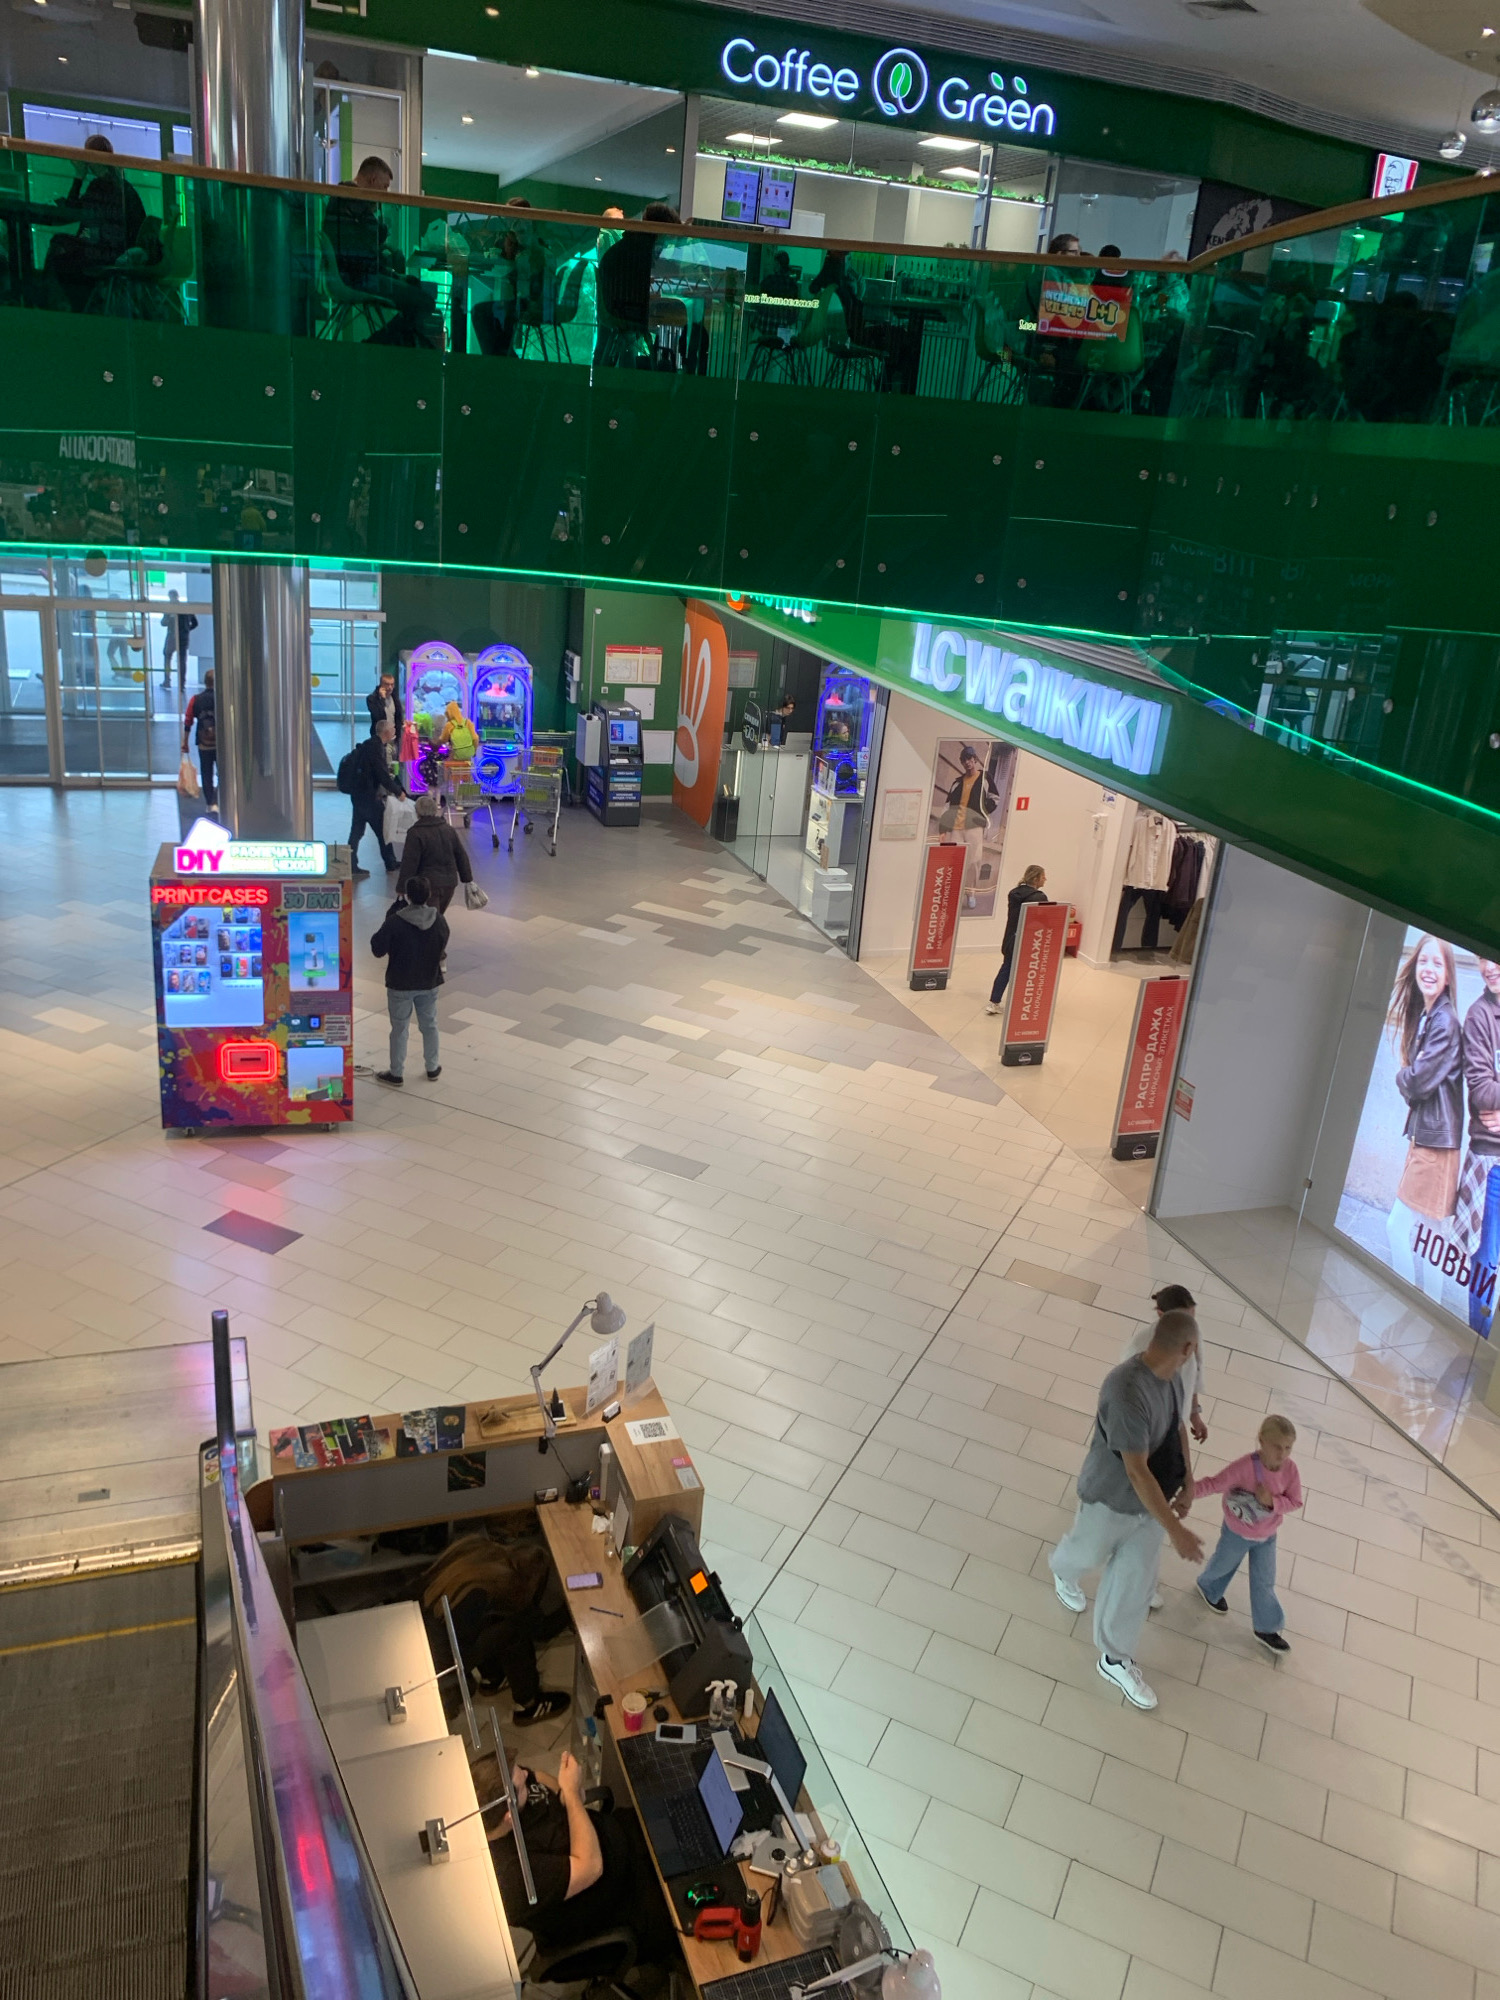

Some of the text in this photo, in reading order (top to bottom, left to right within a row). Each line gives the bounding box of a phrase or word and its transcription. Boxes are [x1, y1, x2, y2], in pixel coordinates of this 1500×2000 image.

[721, 38, 1056, 136] Coffee Green
[152, 887, 269, 904] PRINT CASES
[177, 849, 224, 871] DIY
[307, 893, 340, 909] BYN
[925, 867, 945, 950] РАСПРОДАЖА
[1021, 929, 1044, 1021] РАСПРОДАЖА
[1034, 974, 1046, 1009] КРАСНЫХ
[1040, 928, 1053, 973] ЭТИКЕТКАХ
[1135, 1006, 1164, 1109] РАСПРОДАЖА
[1158, 1006, 1174, 1056] ЭТИКЕТКАХ
[1413, 1222, 1497, 1305] НОВЫЙ
